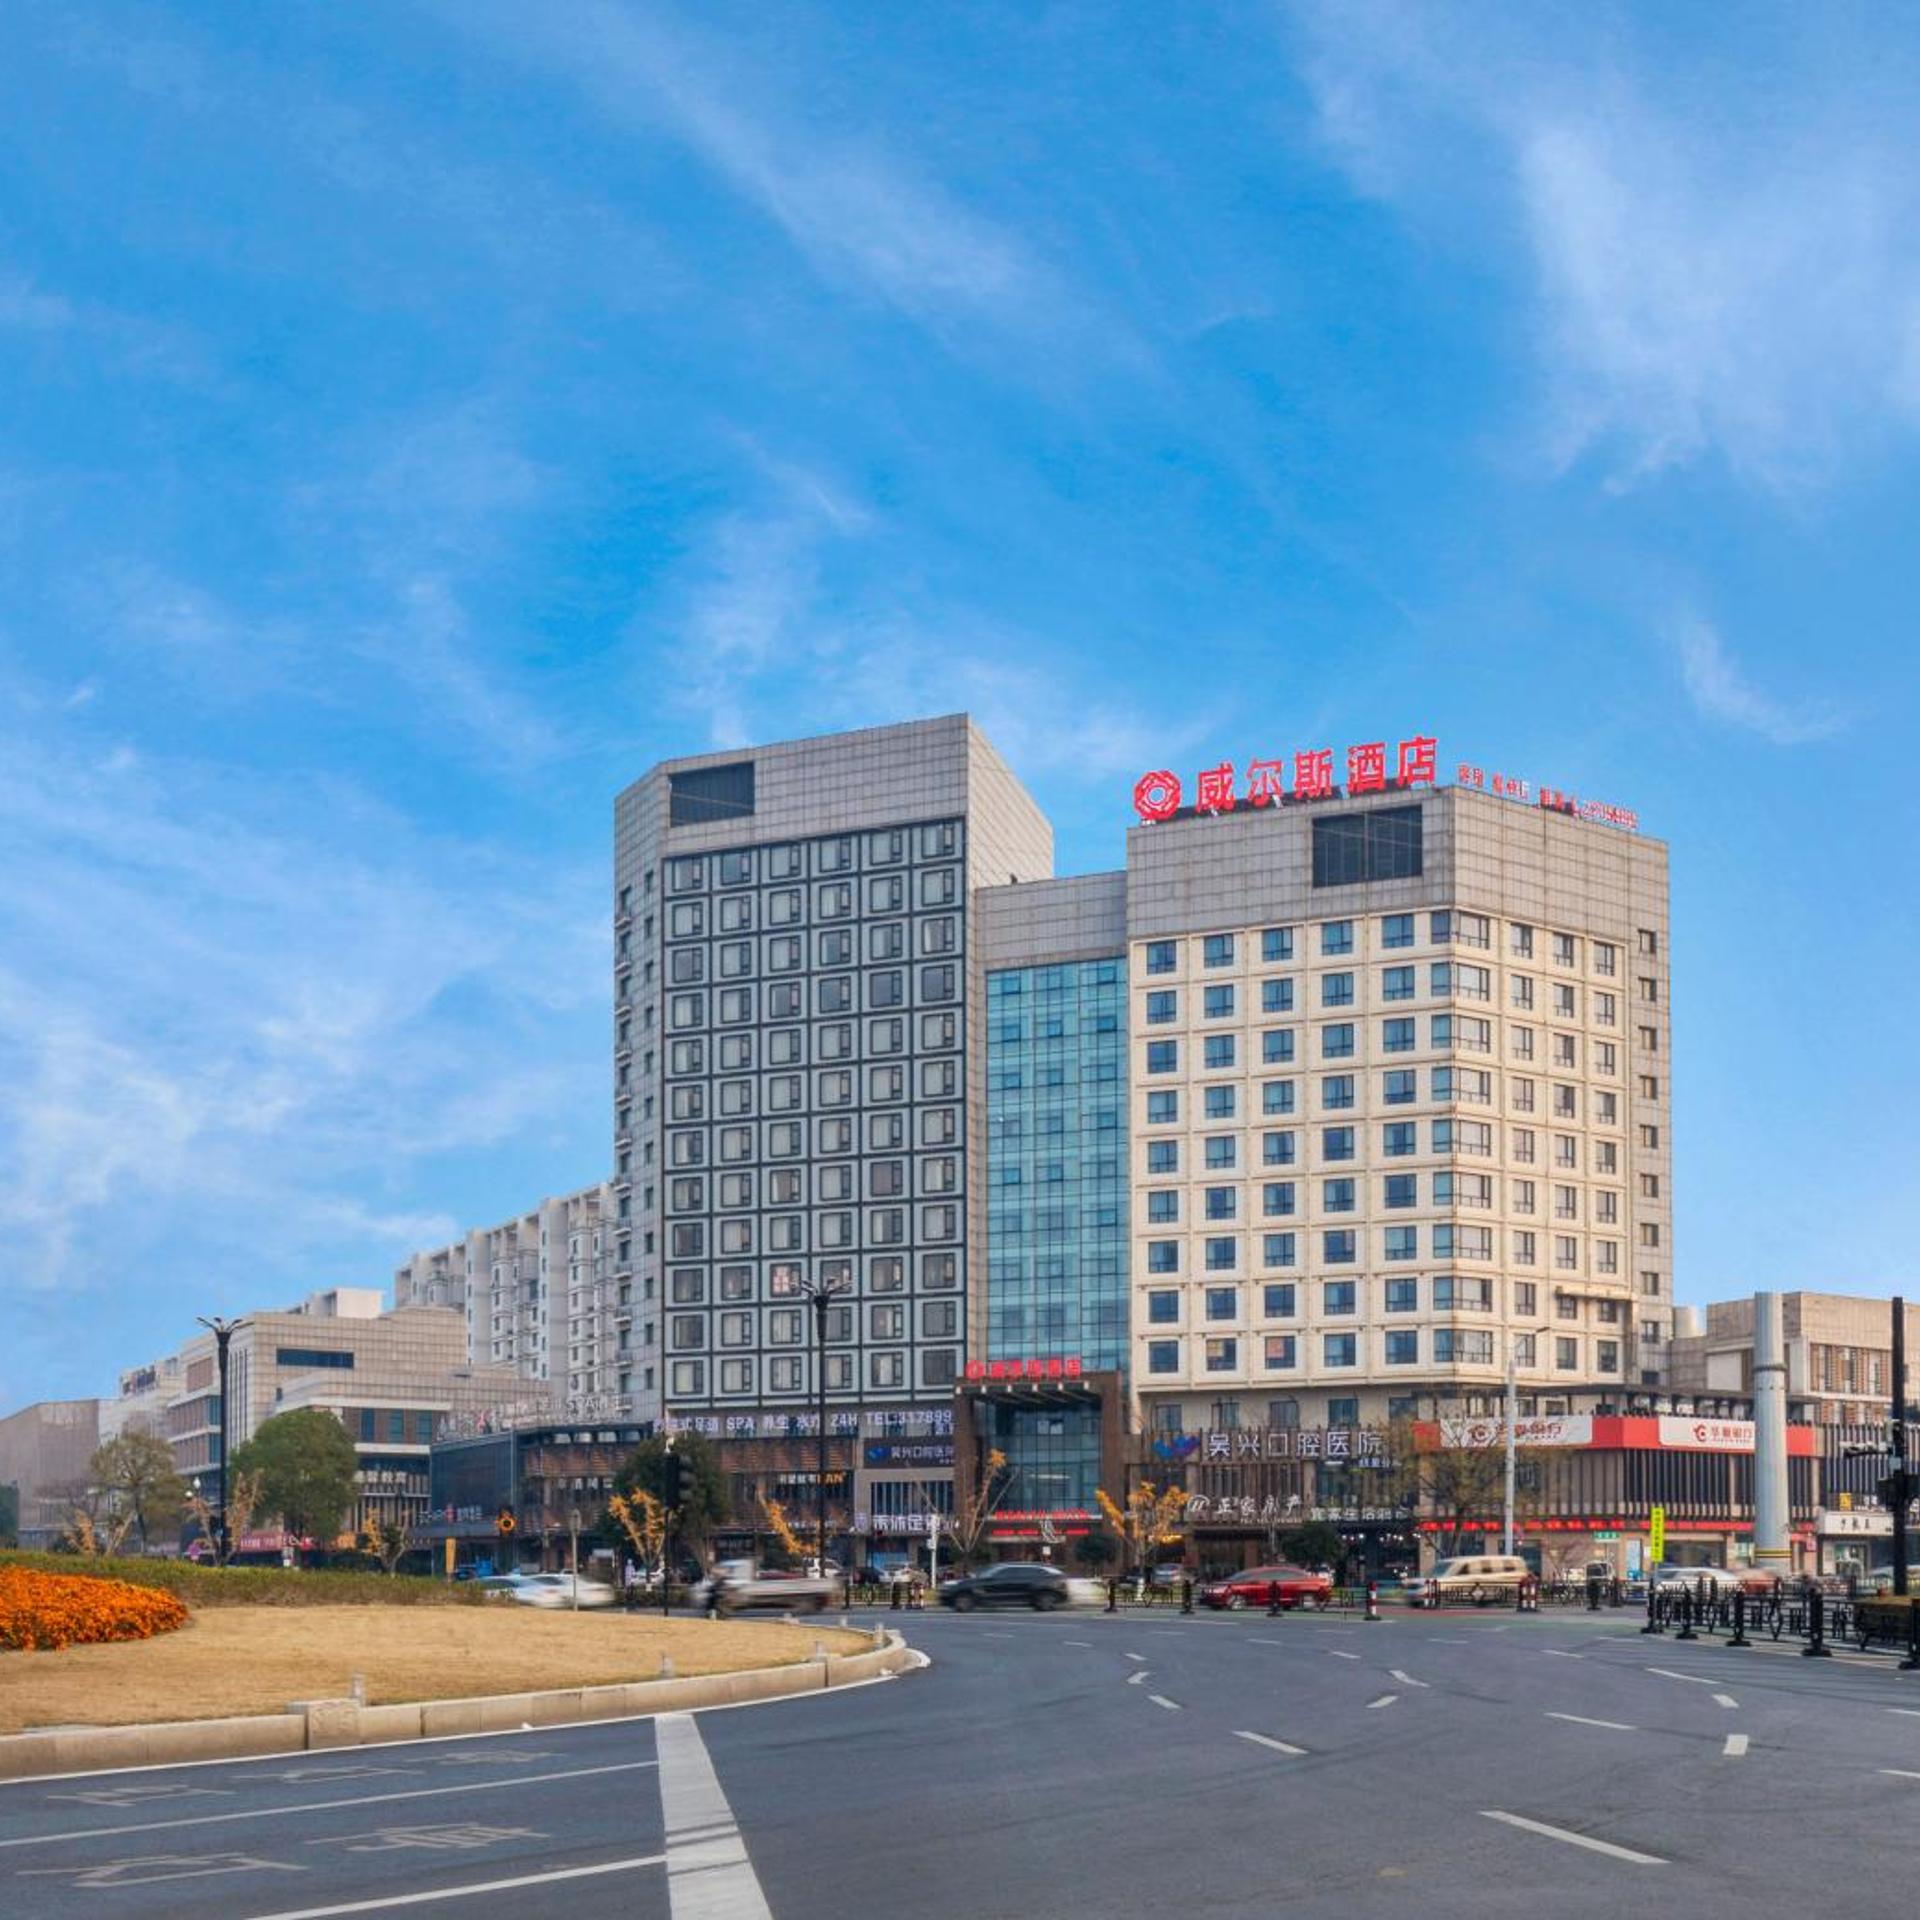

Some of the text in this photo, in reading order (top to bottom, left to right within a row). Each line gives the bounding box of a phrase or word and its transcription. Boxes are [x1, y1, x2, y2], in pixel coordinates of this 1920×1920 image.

[1196, 736, 1438, 812] 威尔斯酒店
[726, 1416, 754, 1430] SPA
[830, 1413, 858, 1427] 24H
[1209, 1431, 1384, 1457] 吴兴口腔医院
